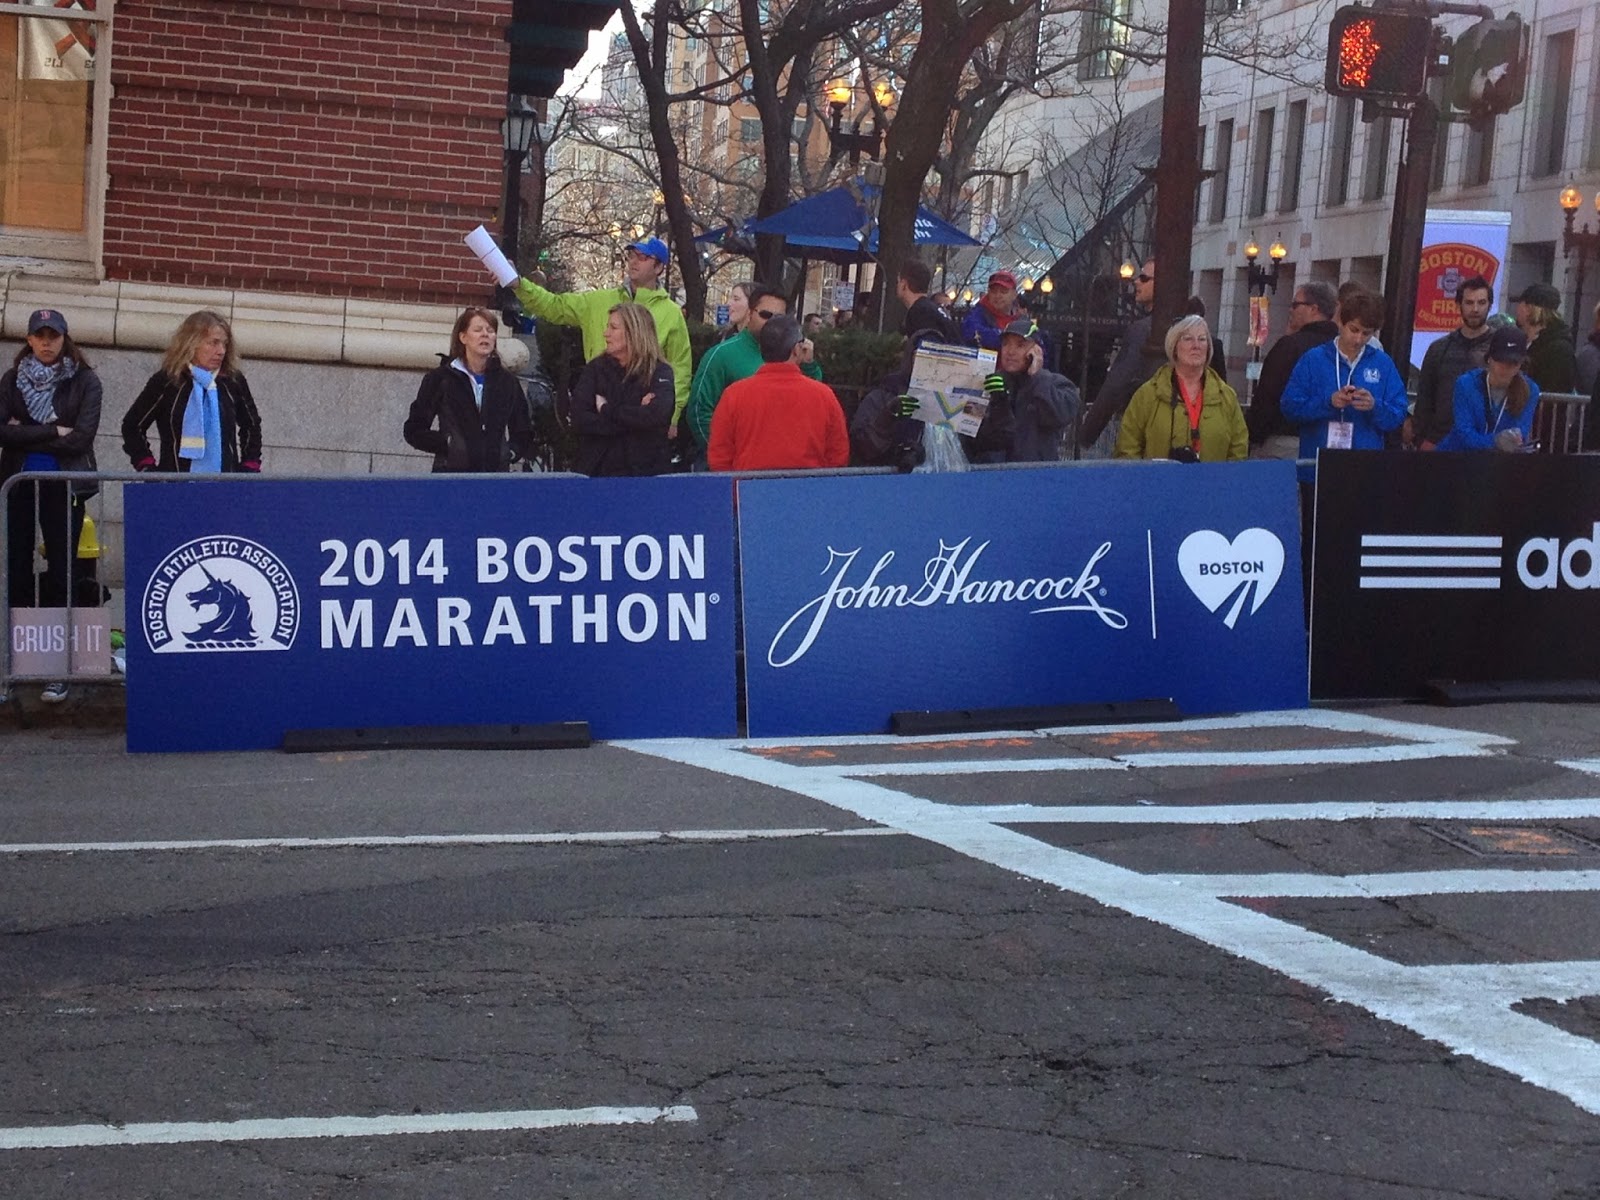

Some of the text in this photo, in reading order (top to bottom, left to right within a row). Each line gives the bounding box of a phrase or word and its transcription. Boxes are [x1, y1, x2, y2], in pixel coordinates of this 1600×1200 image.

[1420, 251, 1488, 273] BOSTON
[1417, 309, 1464, 327] DEPARTM
[1431, 299, 1461, 314] FIR
[320, 534, 705, 586] 2014 BOSTON
[1199, 560, 1264, 576] BOSTON
[148, 541, 295, 643] BOSTON ATHLETIC ASSOCIATION
[767, 545, 908, 667] John
[86, 624, 103, 653] IT
